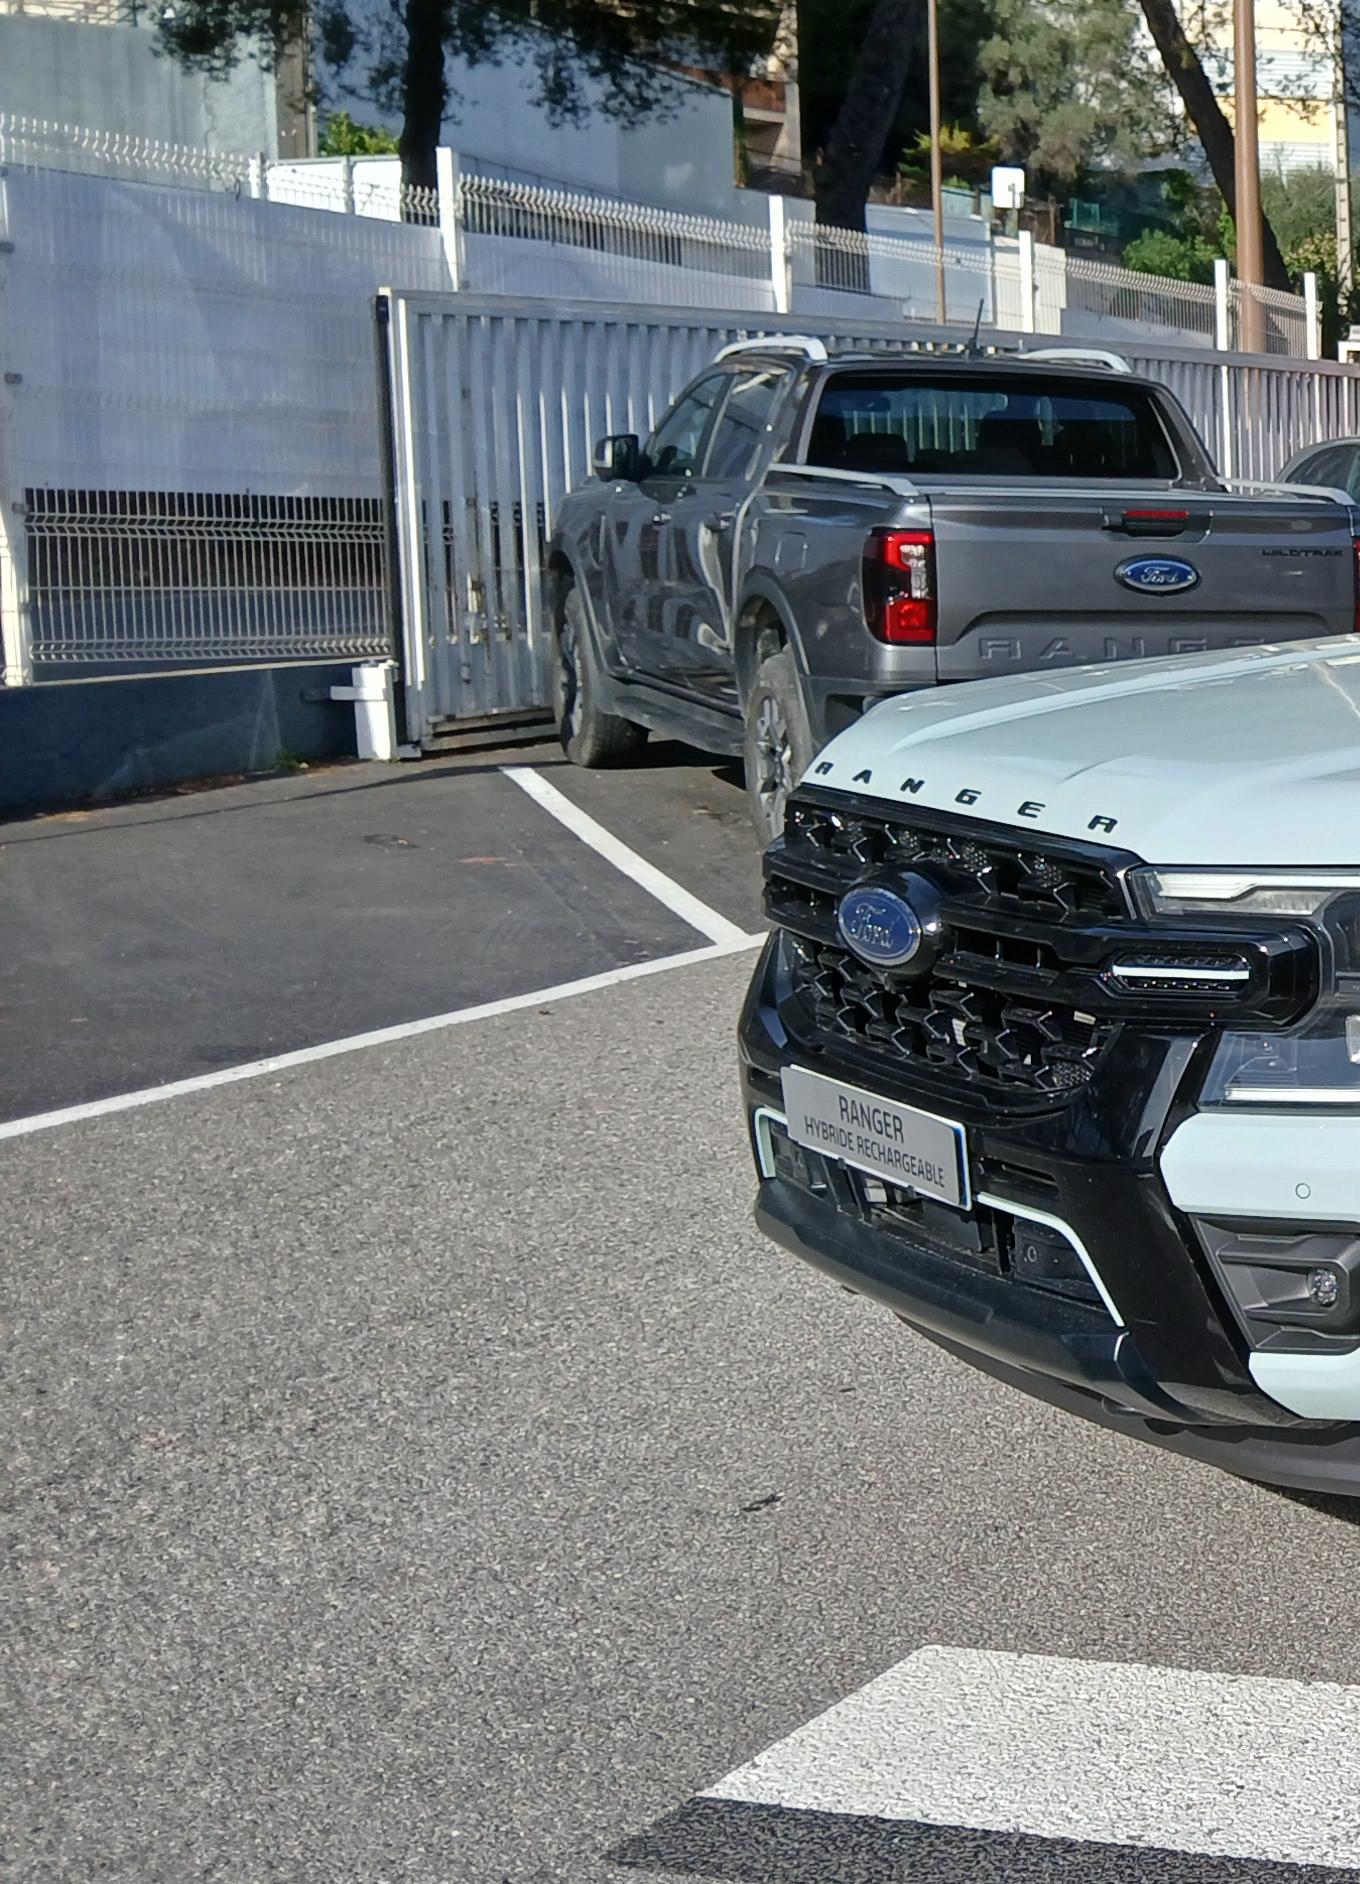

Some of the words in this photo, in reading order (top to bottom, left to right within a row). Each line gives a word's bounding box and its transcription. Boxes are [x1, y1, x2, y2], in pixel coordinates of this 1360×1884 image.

[813, 760, 1119, 834] RANGER
[804, 1115, 854, 1151] HYBRIDE
[857, 1134, 945, 1188] RECHARGEABLE
[838, 1094, 905, 1144] RANGER
